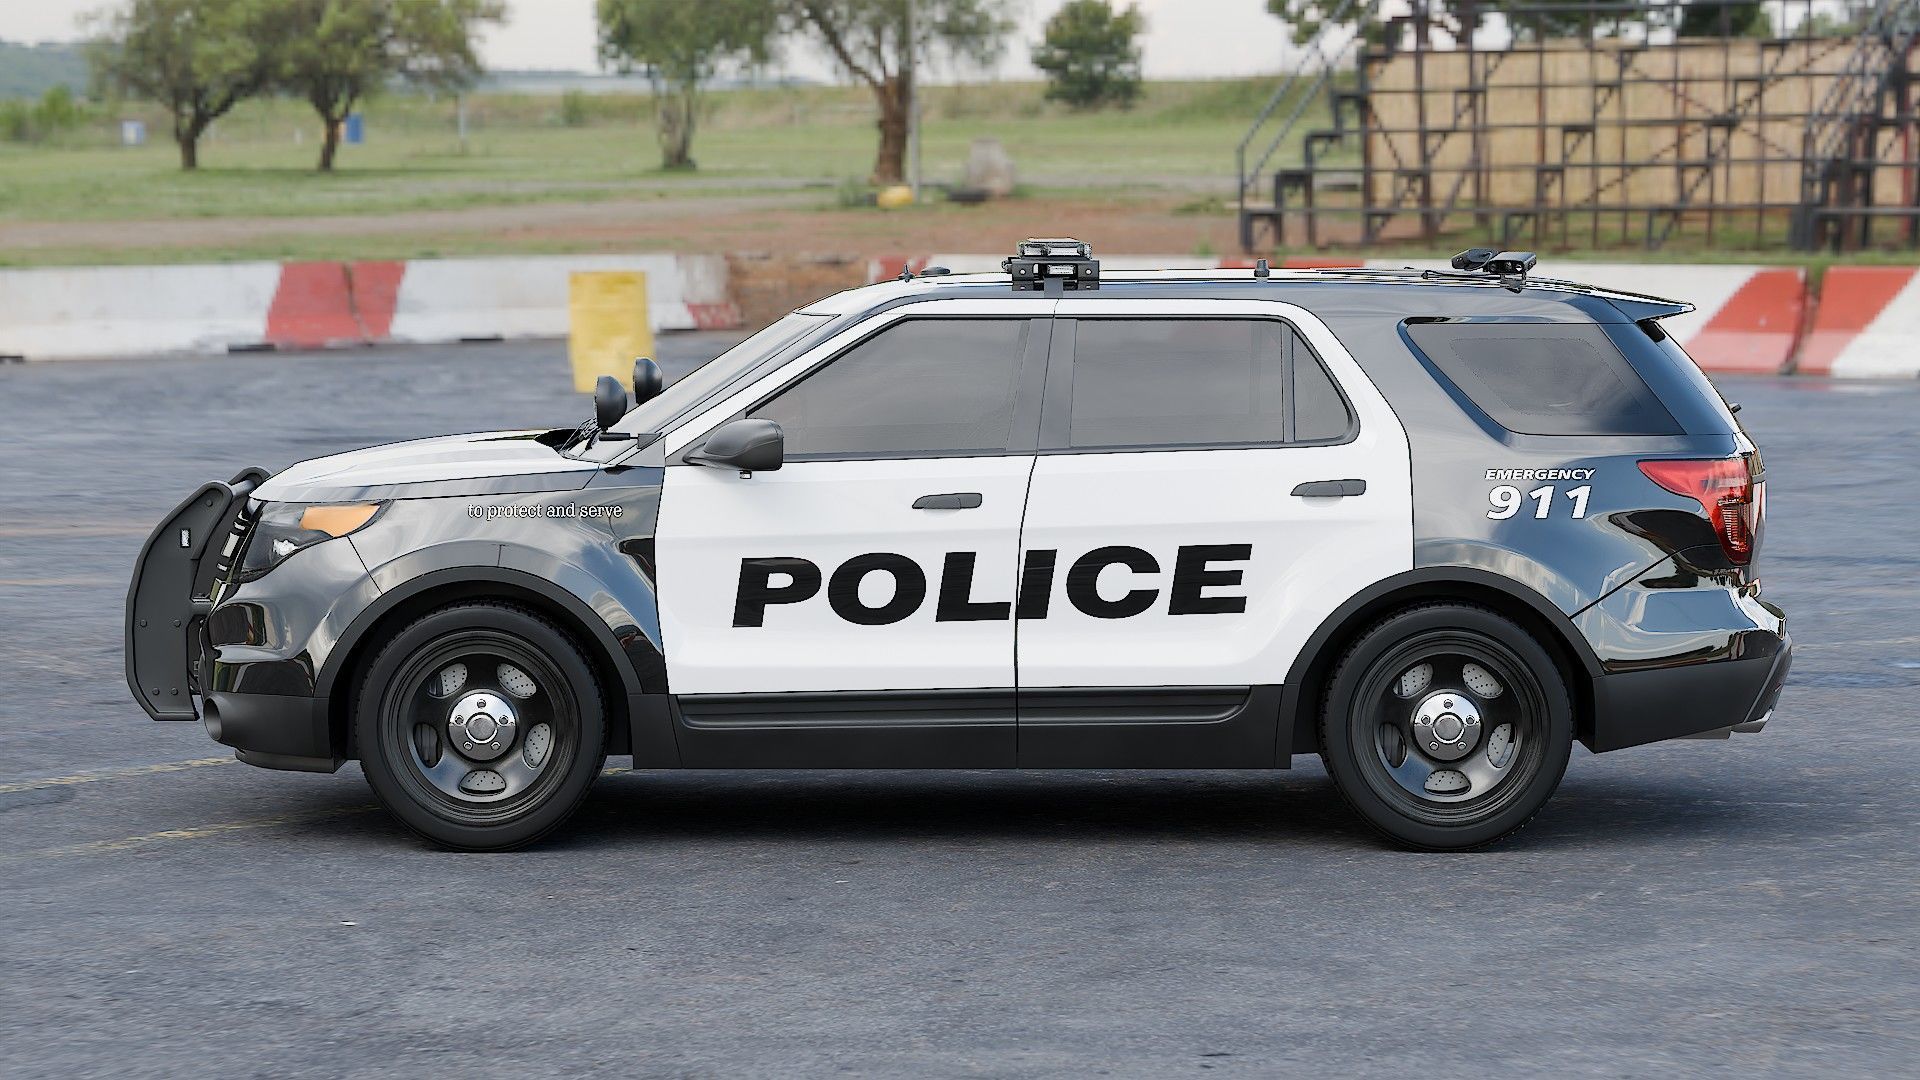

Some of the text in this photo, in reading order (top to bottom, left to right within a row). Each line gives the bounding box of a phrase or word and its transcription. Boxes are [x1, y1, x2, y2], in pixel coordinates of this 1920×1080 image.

[1485, 468, 1596, 481] EMERGENCY
[468, 502, 624, 521] to protect and serve
[1486, 485, 1592, 520] 911
[733, 543, 1253, 628] POLICE
